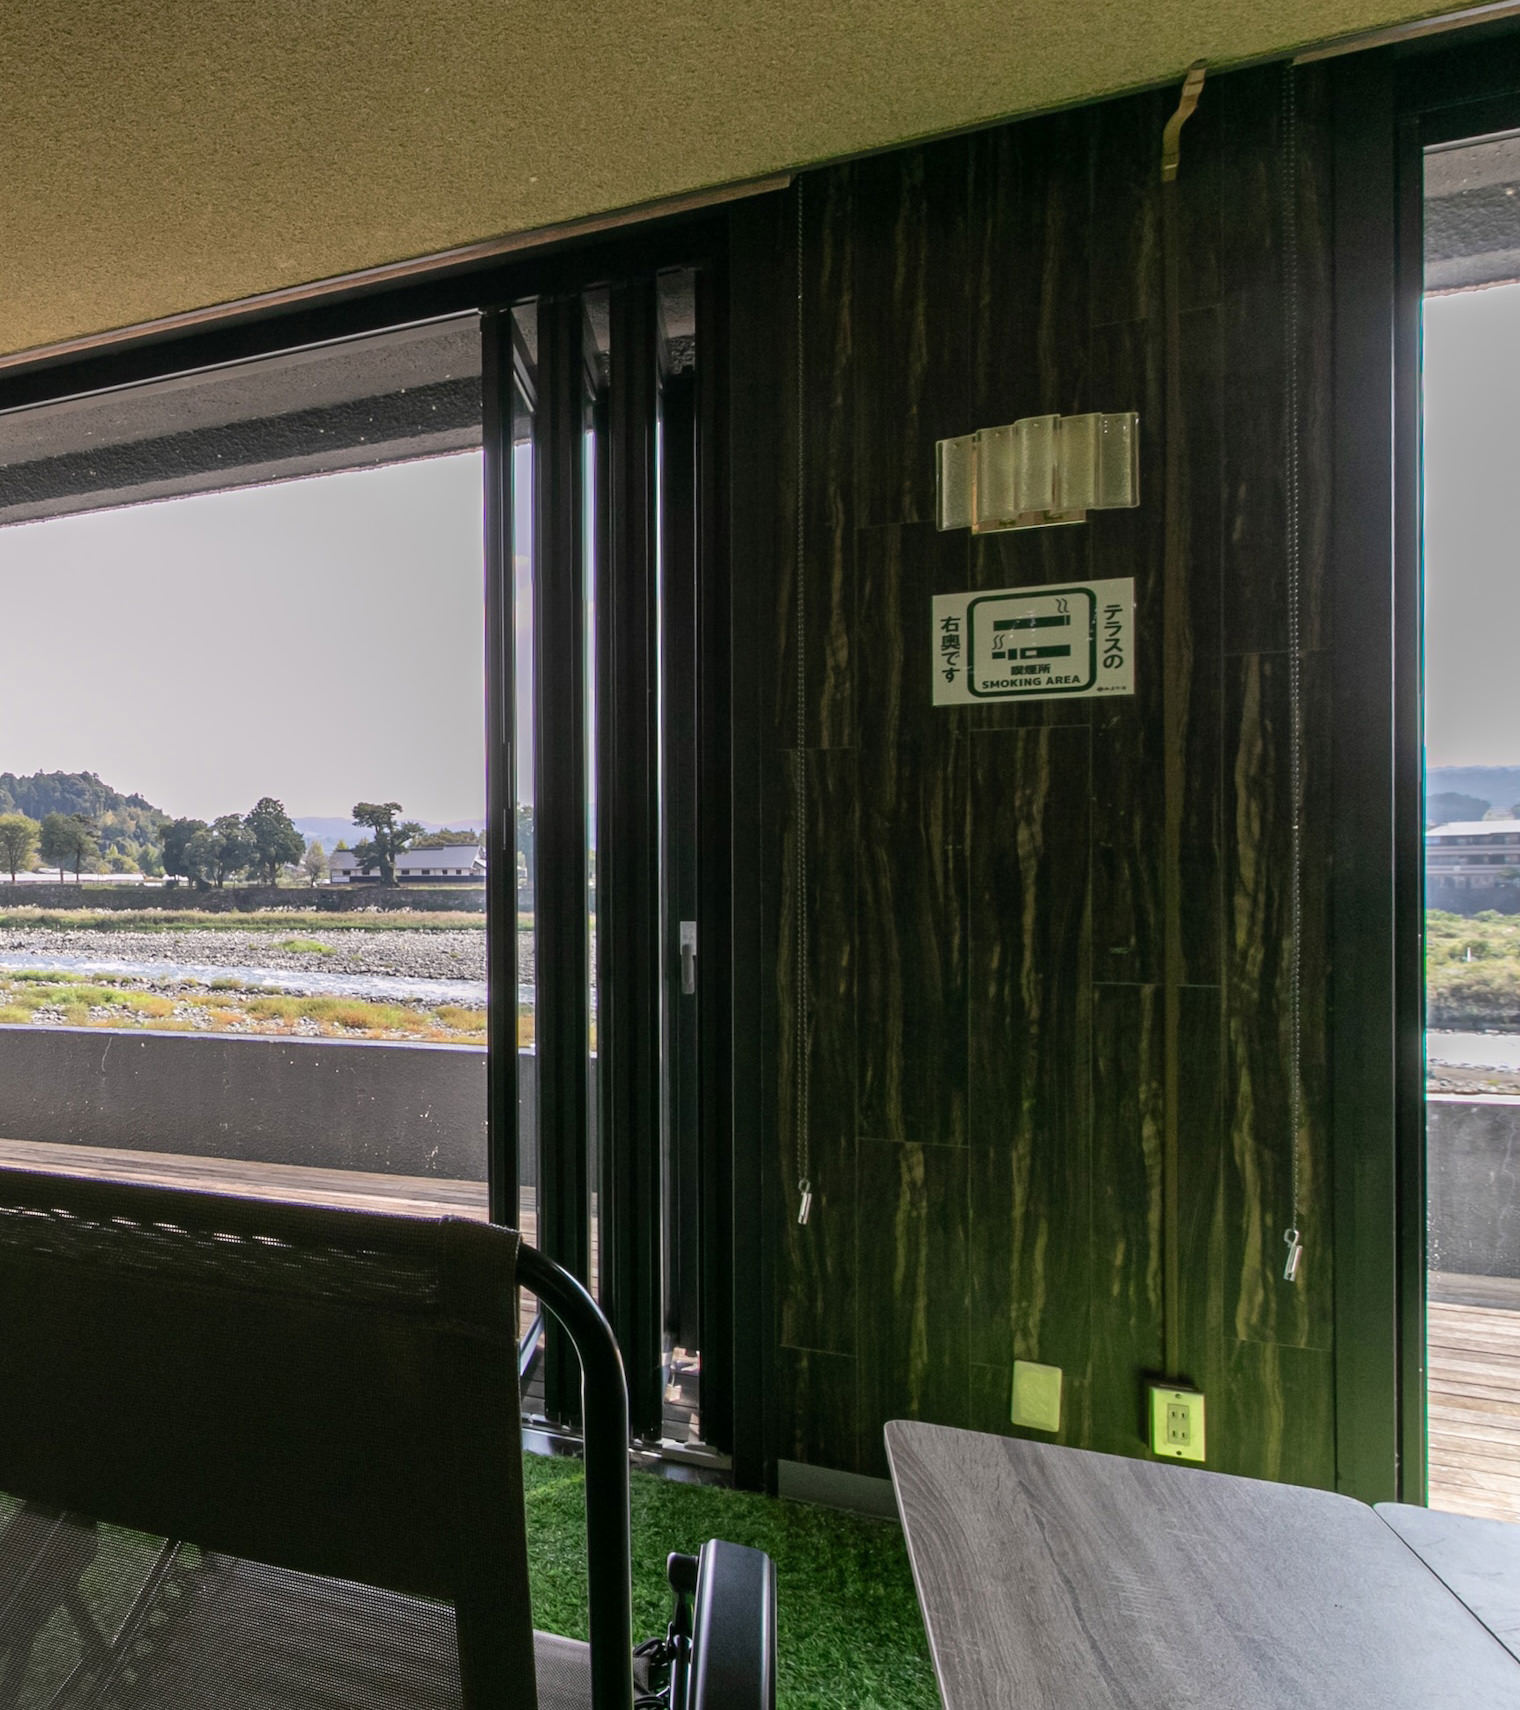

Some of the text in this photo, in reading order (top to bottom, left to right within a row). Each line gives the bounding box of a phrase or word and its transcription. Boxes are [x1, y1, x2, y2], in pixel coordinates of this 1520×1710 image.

[941, 616, 961, 683] 右奥です
[1103, 604, 1123, 669] テラスの
[982, 674, 1080, 689] SMOKING AREA
